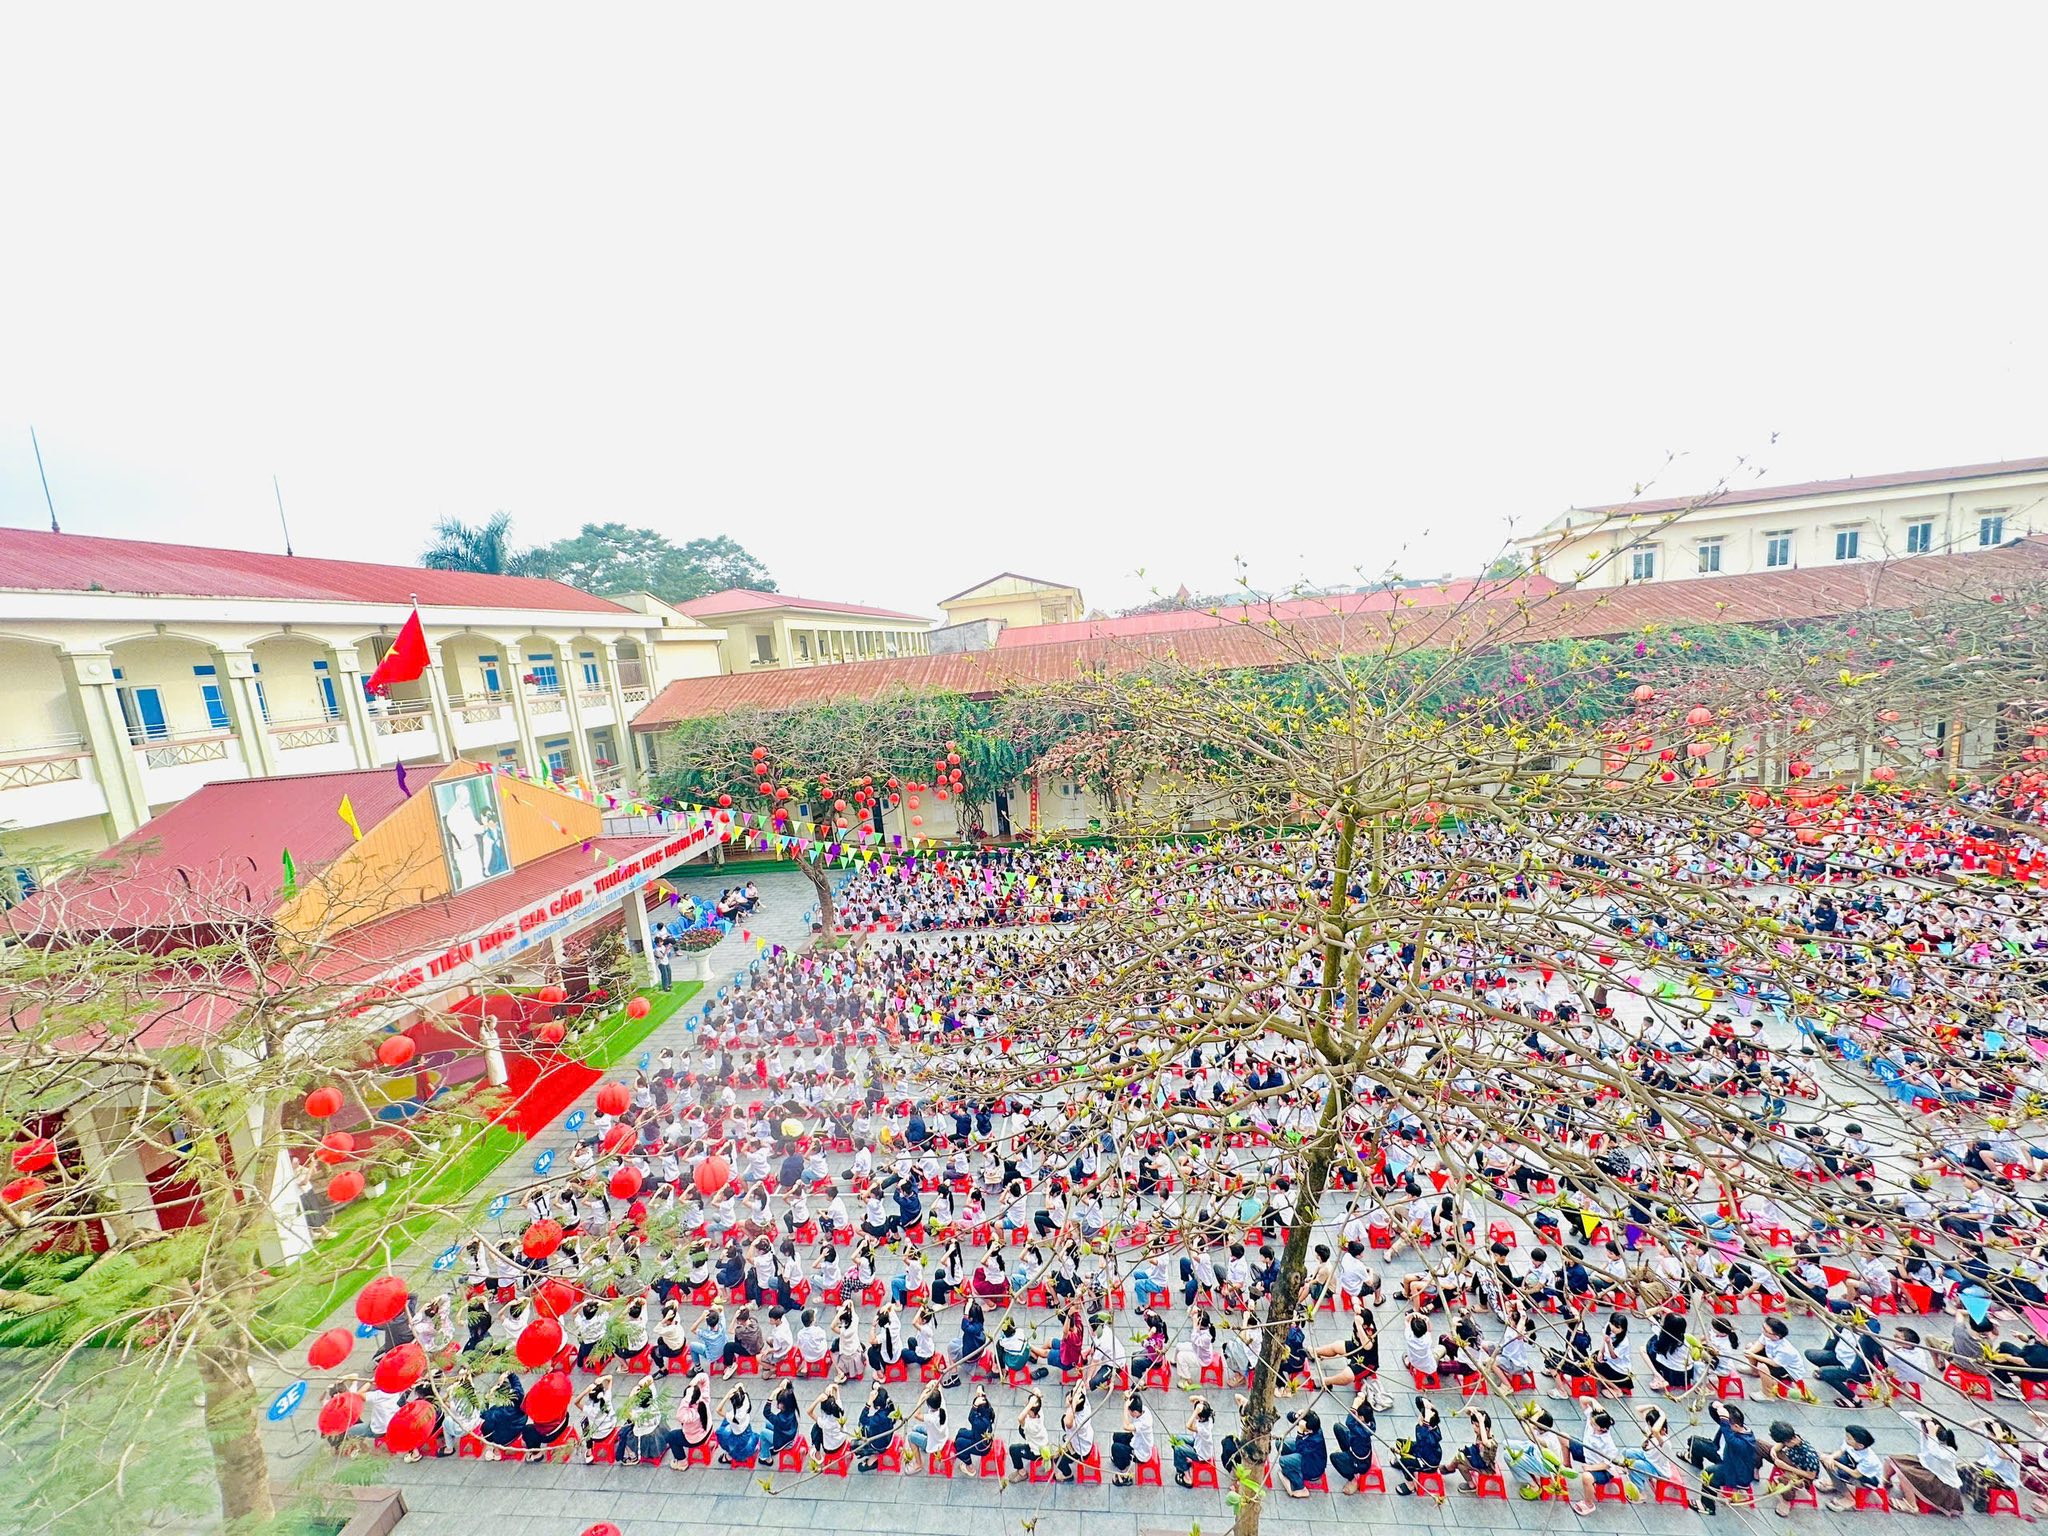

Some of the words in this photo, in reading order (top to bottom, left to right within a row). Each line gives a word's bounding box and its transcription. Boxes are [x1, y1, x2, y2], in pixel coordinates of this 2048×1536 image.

[479, 923, 517, 953] HỌC
[519, 907, 548, 932] GIA
[550, 889, 584, 916] CẨM
[642, 849, 664, 870] HỌC
[665, 835, 692, 858] HẠNH
[570, 1112, 582, 1127] 1K
[538, 1152, 551, 1169] 3A
[275, 1384, 302, 1414] 3E
